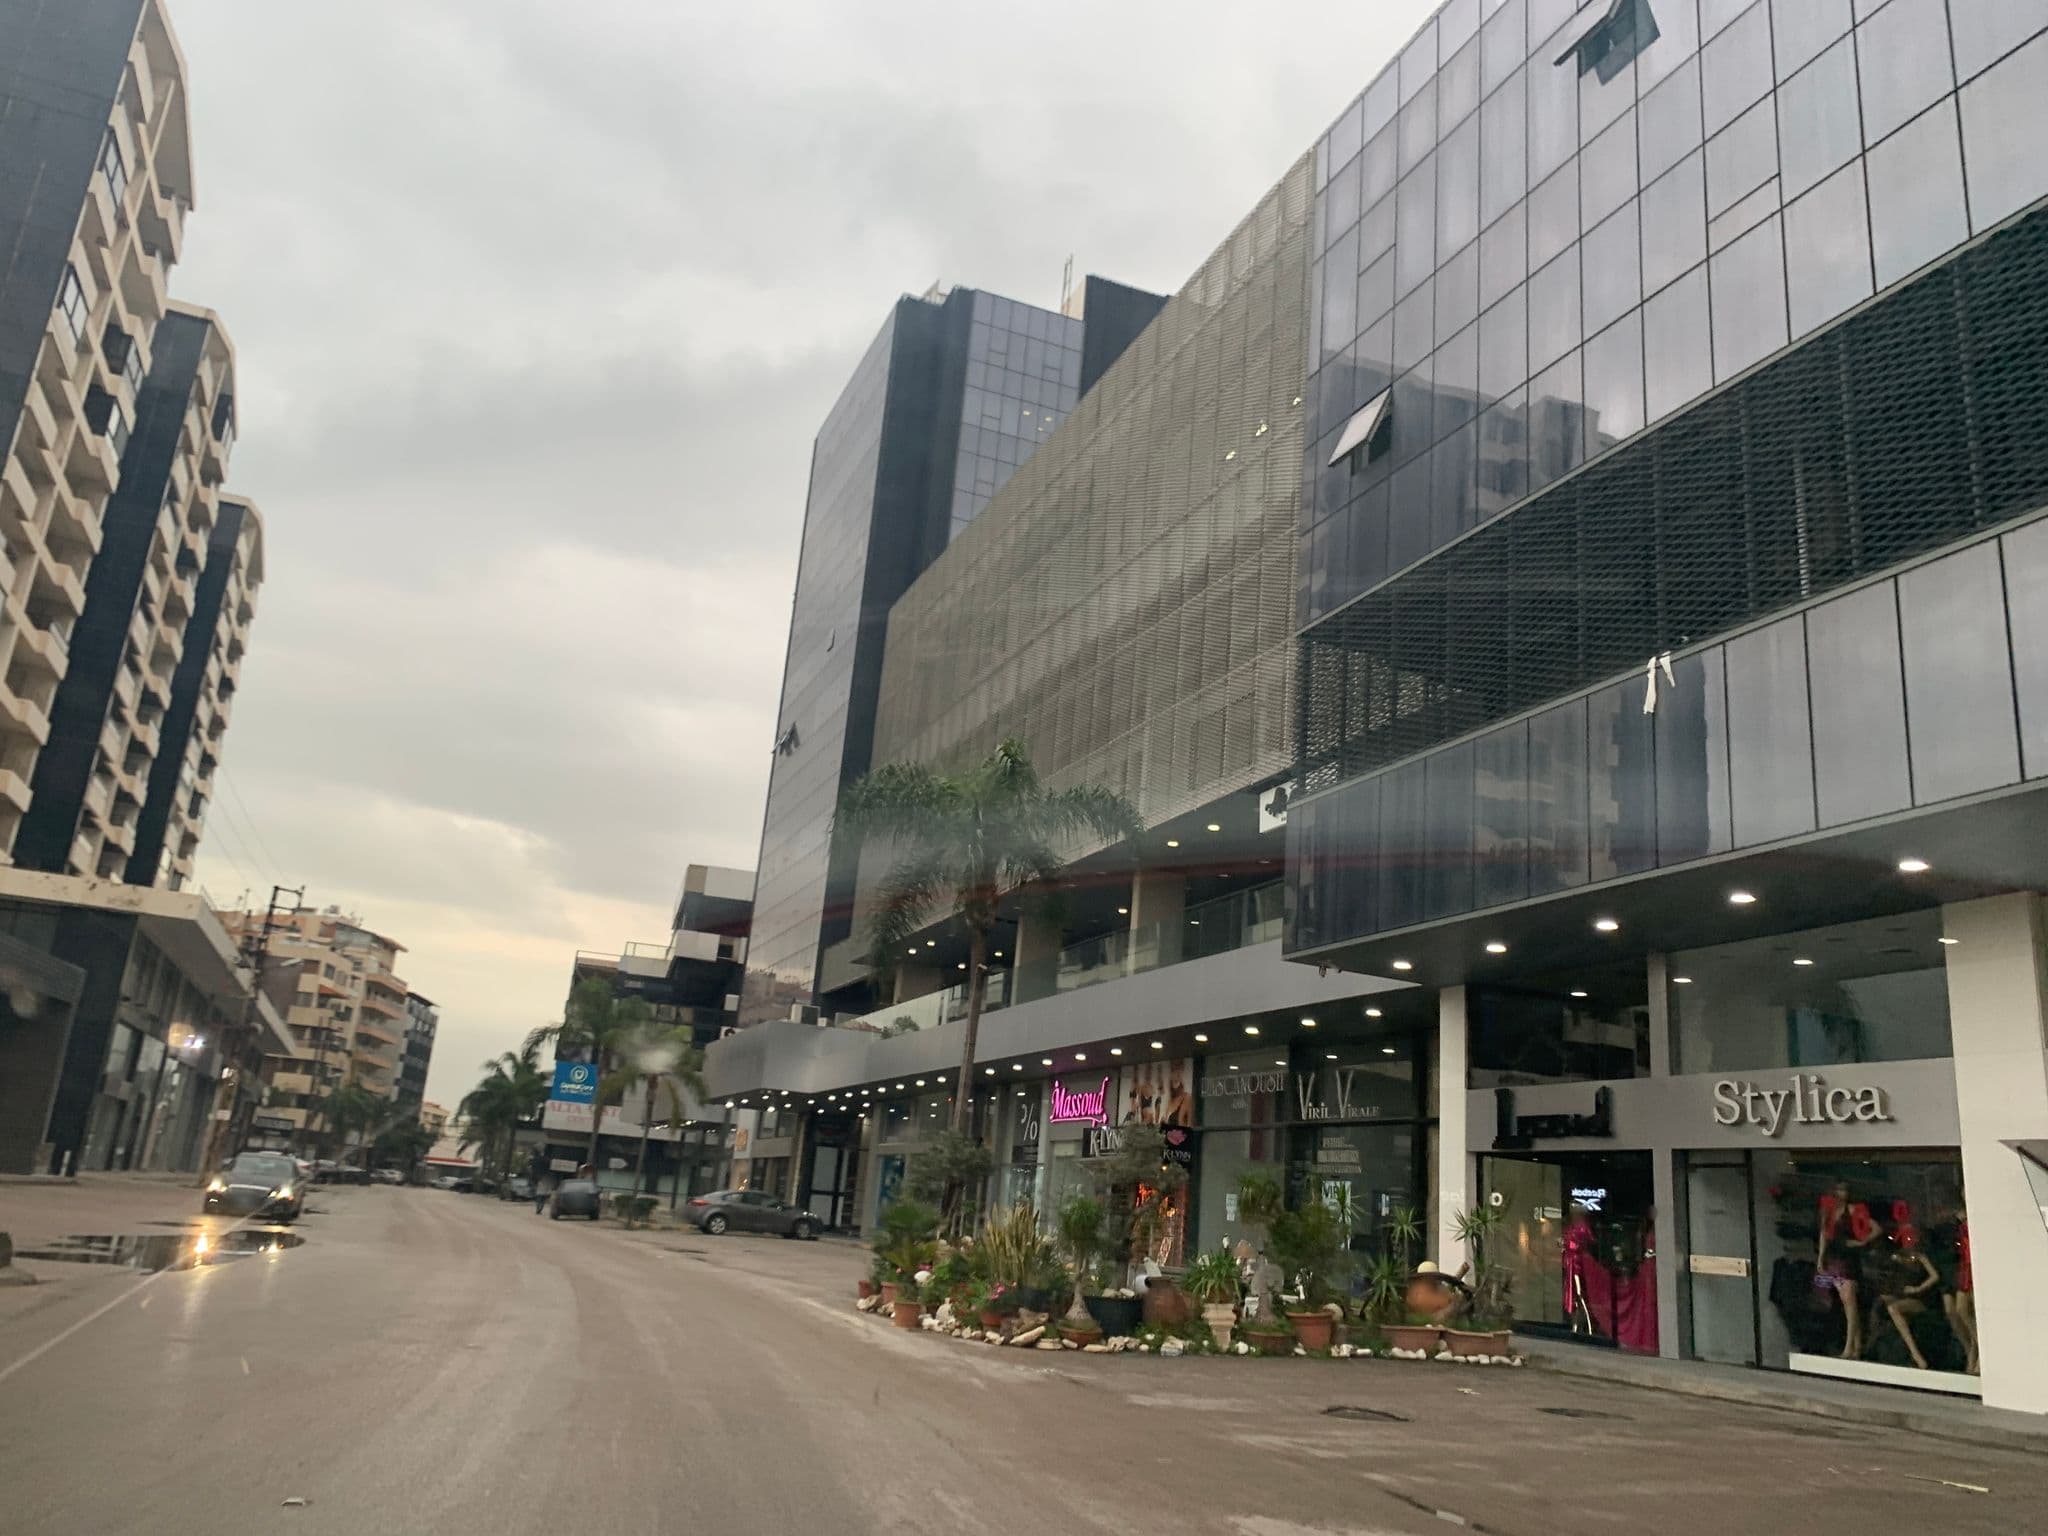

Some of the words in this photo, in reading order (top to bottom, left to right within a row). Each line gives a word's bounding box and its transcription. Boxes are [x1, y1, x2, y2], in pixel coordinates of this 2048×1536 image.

[1049, 1076, 1109, 1127] Massoud
[1713, 1074, 1887, 1136] Stylica
[1089, 1128, 1124, 1157] K-LYN
